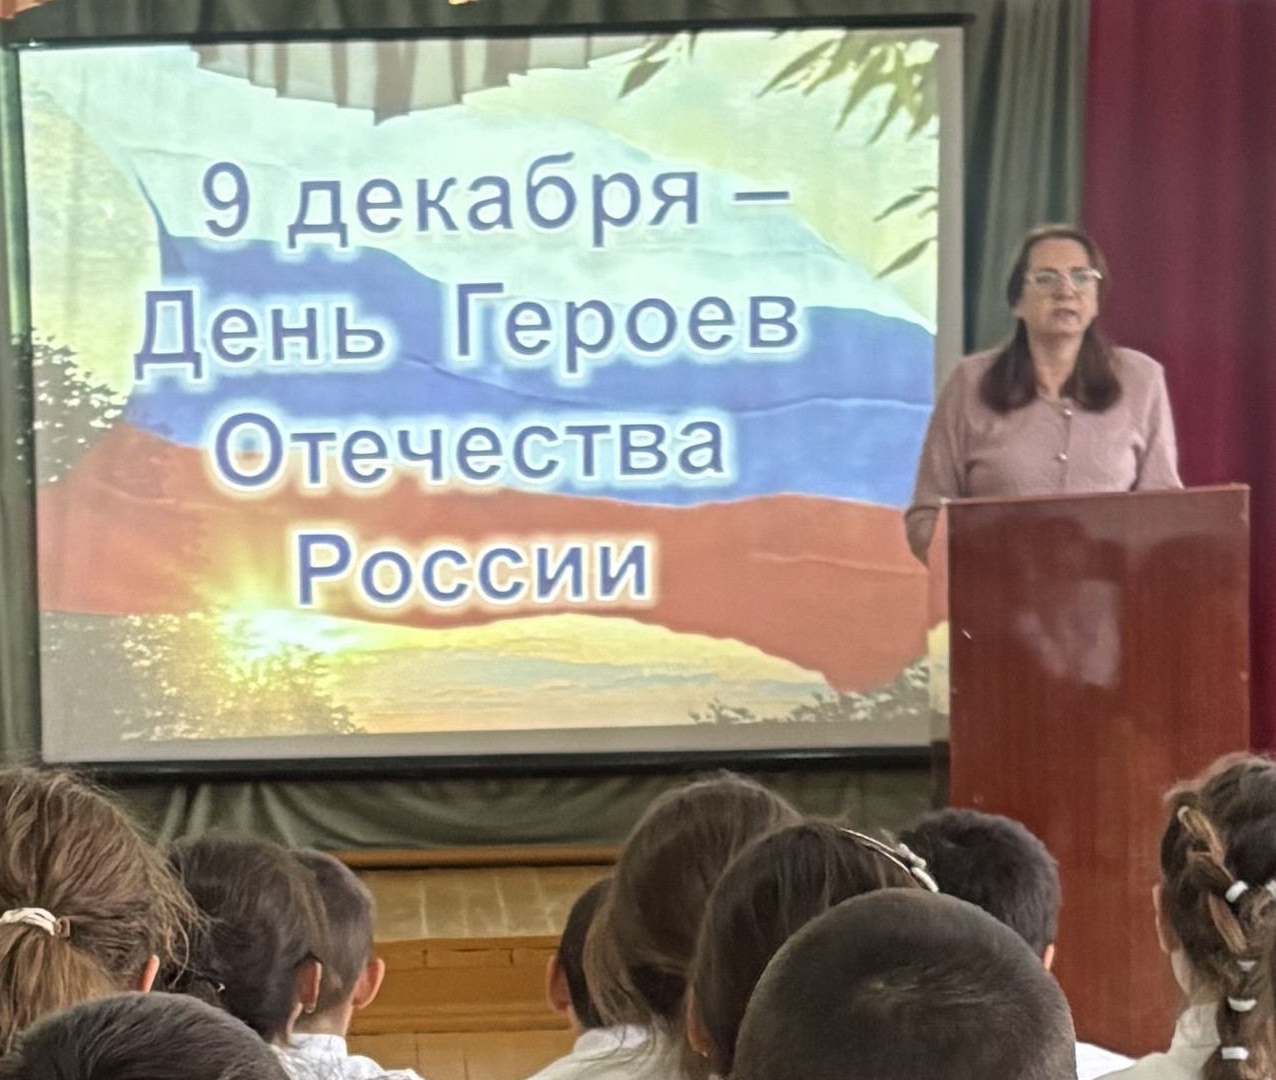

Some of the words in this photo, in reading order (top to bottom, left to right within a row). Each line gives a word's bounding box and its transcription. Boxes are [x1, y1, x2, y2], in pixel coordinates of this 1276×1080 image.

[201, 161, 251, 237] 9
[288, 152, 701, 247] декабря
[133, 290, 386, 379] День
[455, 283, 800, 373] Героев
[214, 412, 726, 488] Отечества
[296, 532, 649, 606] России
